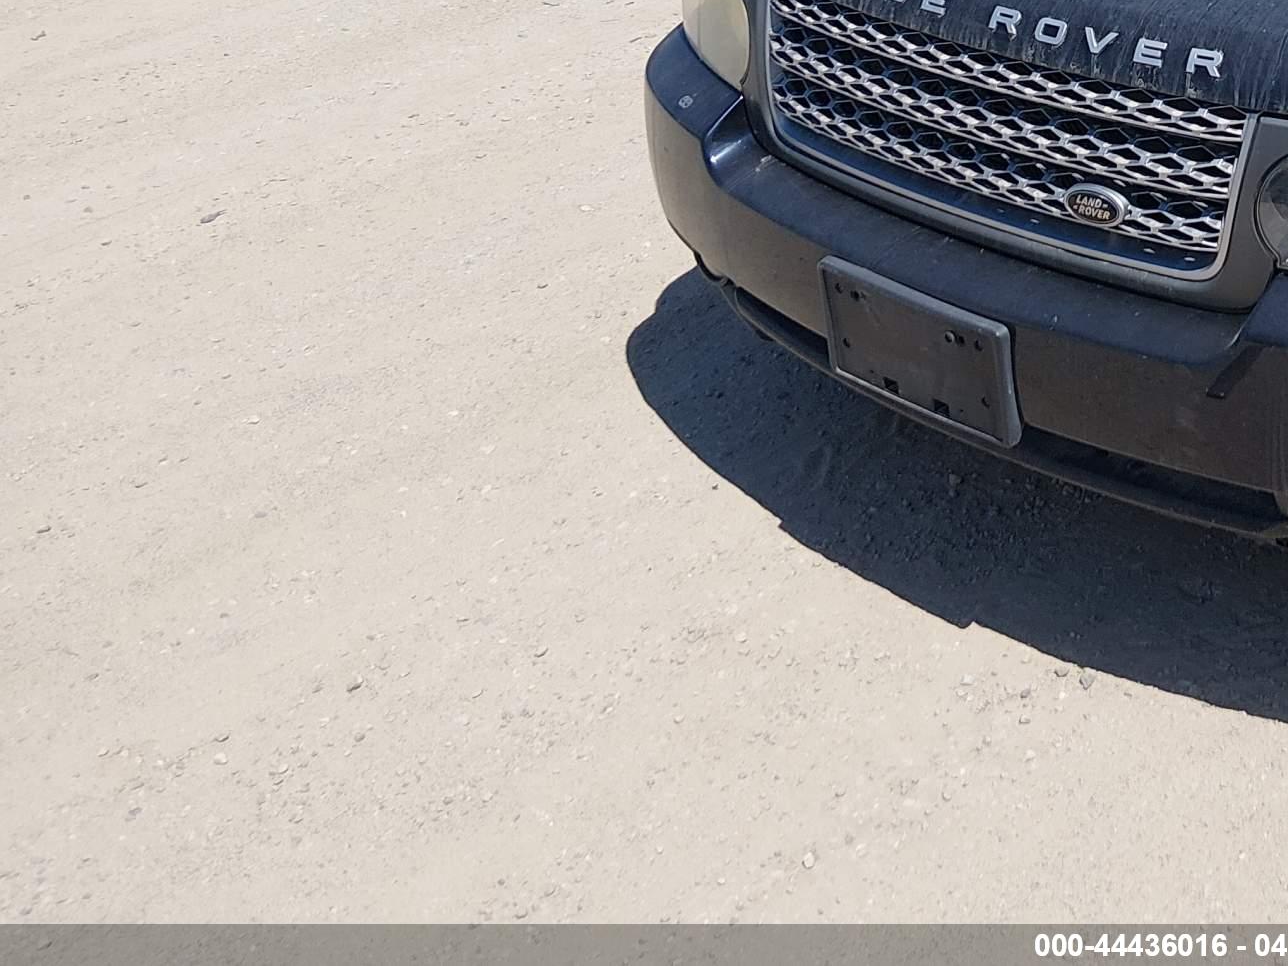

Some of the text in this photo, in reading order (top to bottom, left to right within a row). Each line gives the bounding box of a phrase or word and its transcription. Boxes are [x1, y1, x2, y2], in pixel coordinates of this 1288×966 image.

[988, 5, 1225, 79] ROVER
[1076, 194, 1103, 209] LAND
[1078, 204, 1111, 221] ROVER
